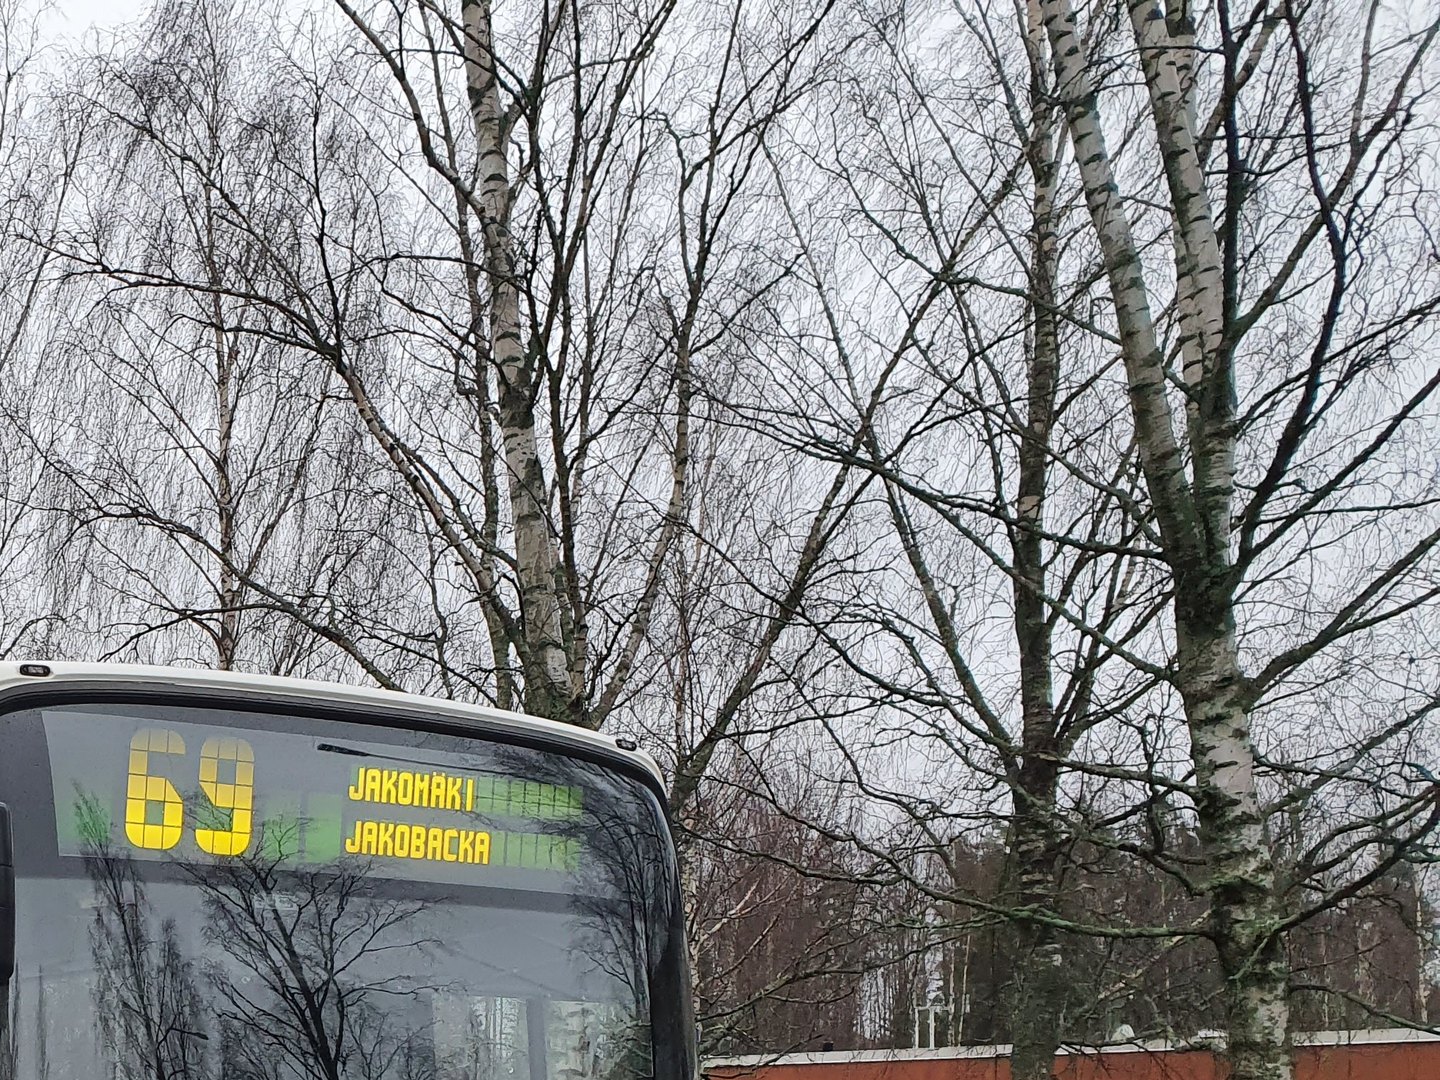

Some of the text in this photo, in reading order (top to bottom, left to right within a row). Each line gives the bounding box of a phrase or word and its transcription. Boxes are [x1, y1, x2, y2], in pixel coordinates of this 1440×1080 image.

[125, 727, 255, 856] 69
[348, 767, 475, 812] JAKOMÄKI
[345, 820, 491, 865] JAKOBACKA
